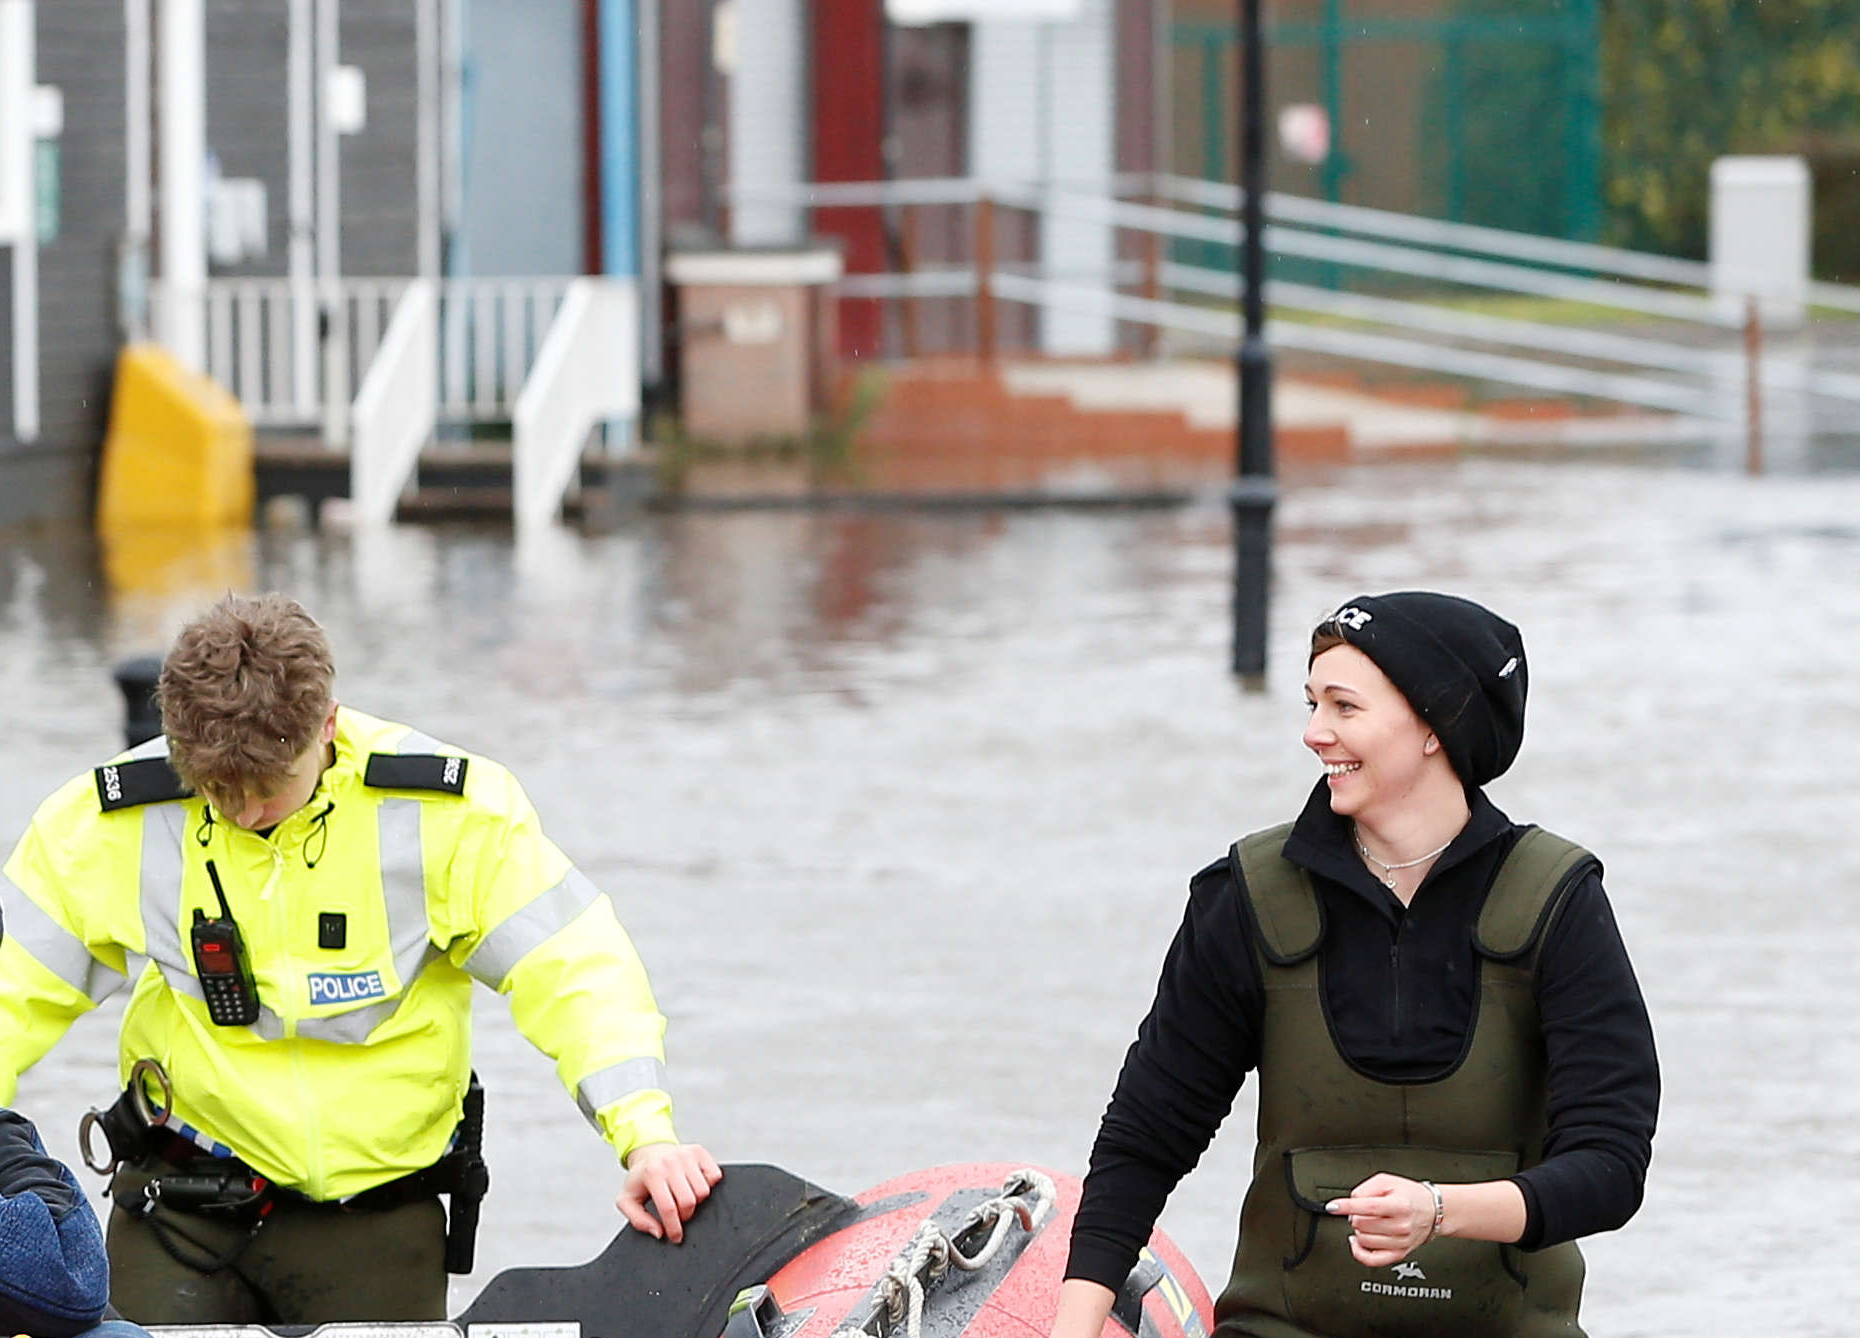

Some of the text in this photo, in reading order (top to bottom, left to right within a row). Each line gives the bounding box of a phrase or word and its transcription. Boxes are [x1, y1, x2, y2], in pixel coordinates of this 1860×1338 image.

[1328, 607, 1372, 630] ICE
[103, 766, 121, 801] 2536
[310, 974, 383, 1000] POLICE
[1361, 1282, 1452, 1299] CORMORAN
